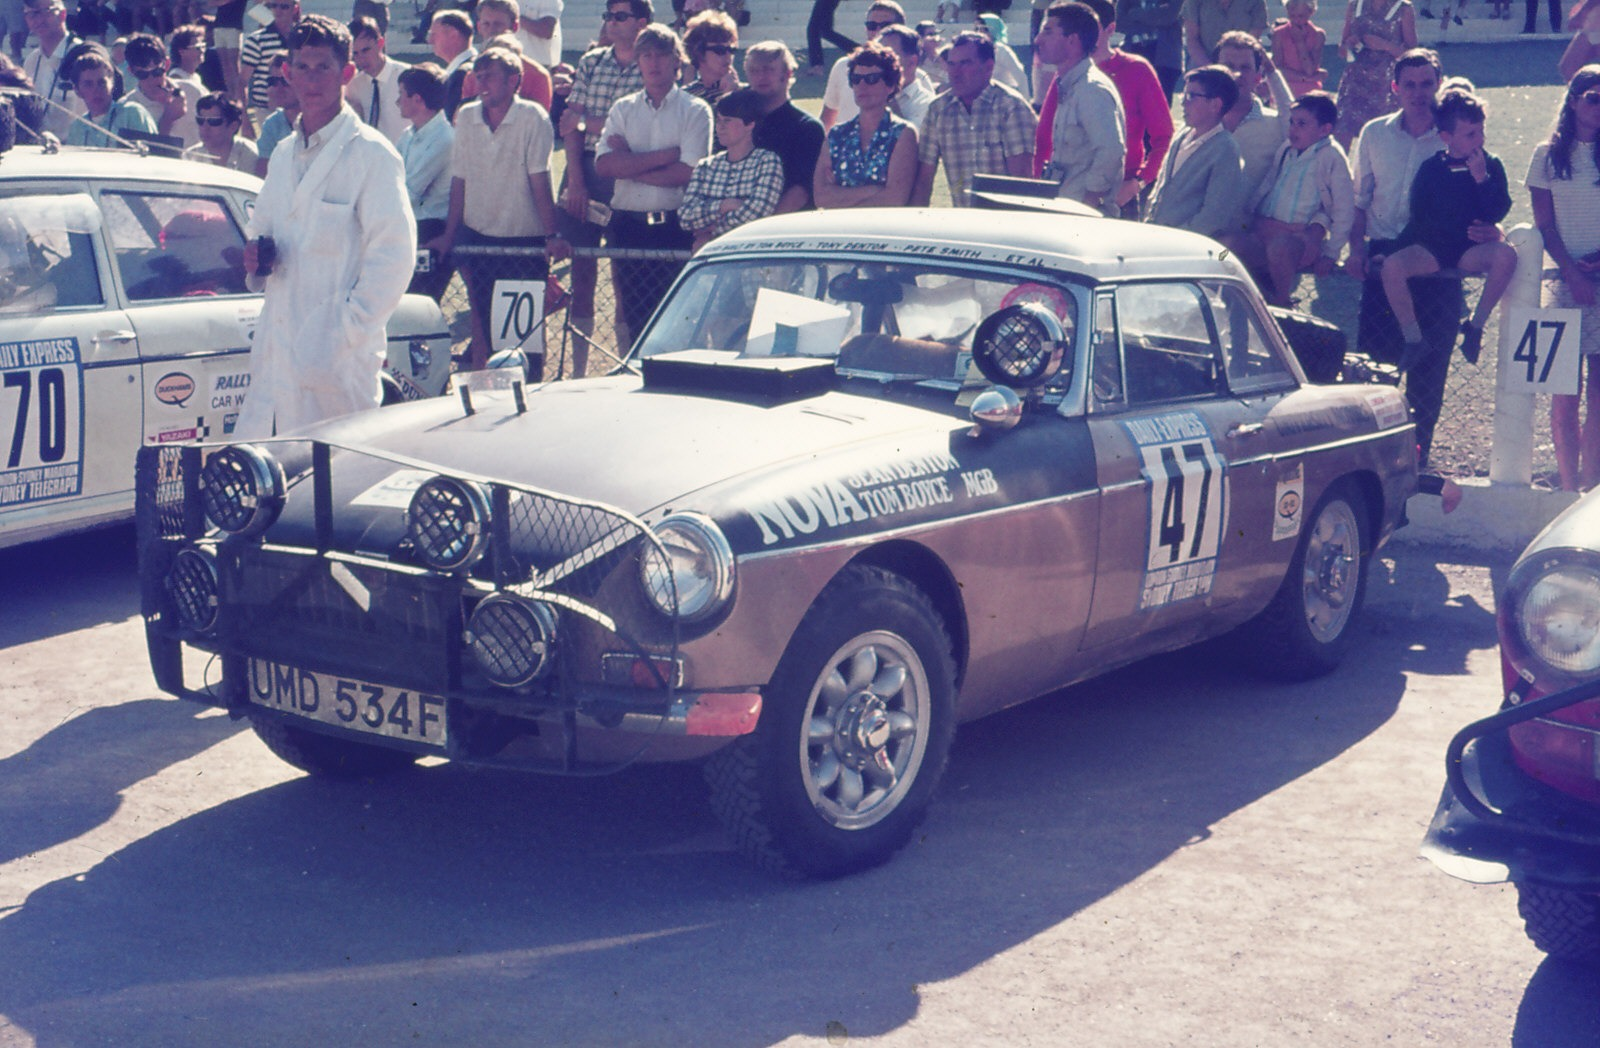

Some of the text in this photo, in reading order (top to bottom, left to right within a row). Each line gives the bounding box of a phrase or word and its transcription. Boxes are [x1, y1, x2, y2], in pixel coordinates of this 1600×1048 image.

[817, 241, 841, 249] TONY
[844, 242, 888, 250] DENTON
[903, 244, 937, 253] PETE
[940, 247, 982, 258] SMITH
[1005, 254, 1024, 263] ET
[500, 291, 535, 340] 70
[21, 339, 75, 366] EXPRESS
[1513, 319, 1567, 383] 47
[3, 368, 66, 468] 70
[211, 394, 231, 409] CAR
[30, 476, 78, 500] TELEGRAPH
[747, 478, 869, 545] NOVA
[858, 468, 999, 519] TOM BOYCE MGB
[1159, 443, 1212, 564] 47
[250, 657, 445, 737] UMD 534F
